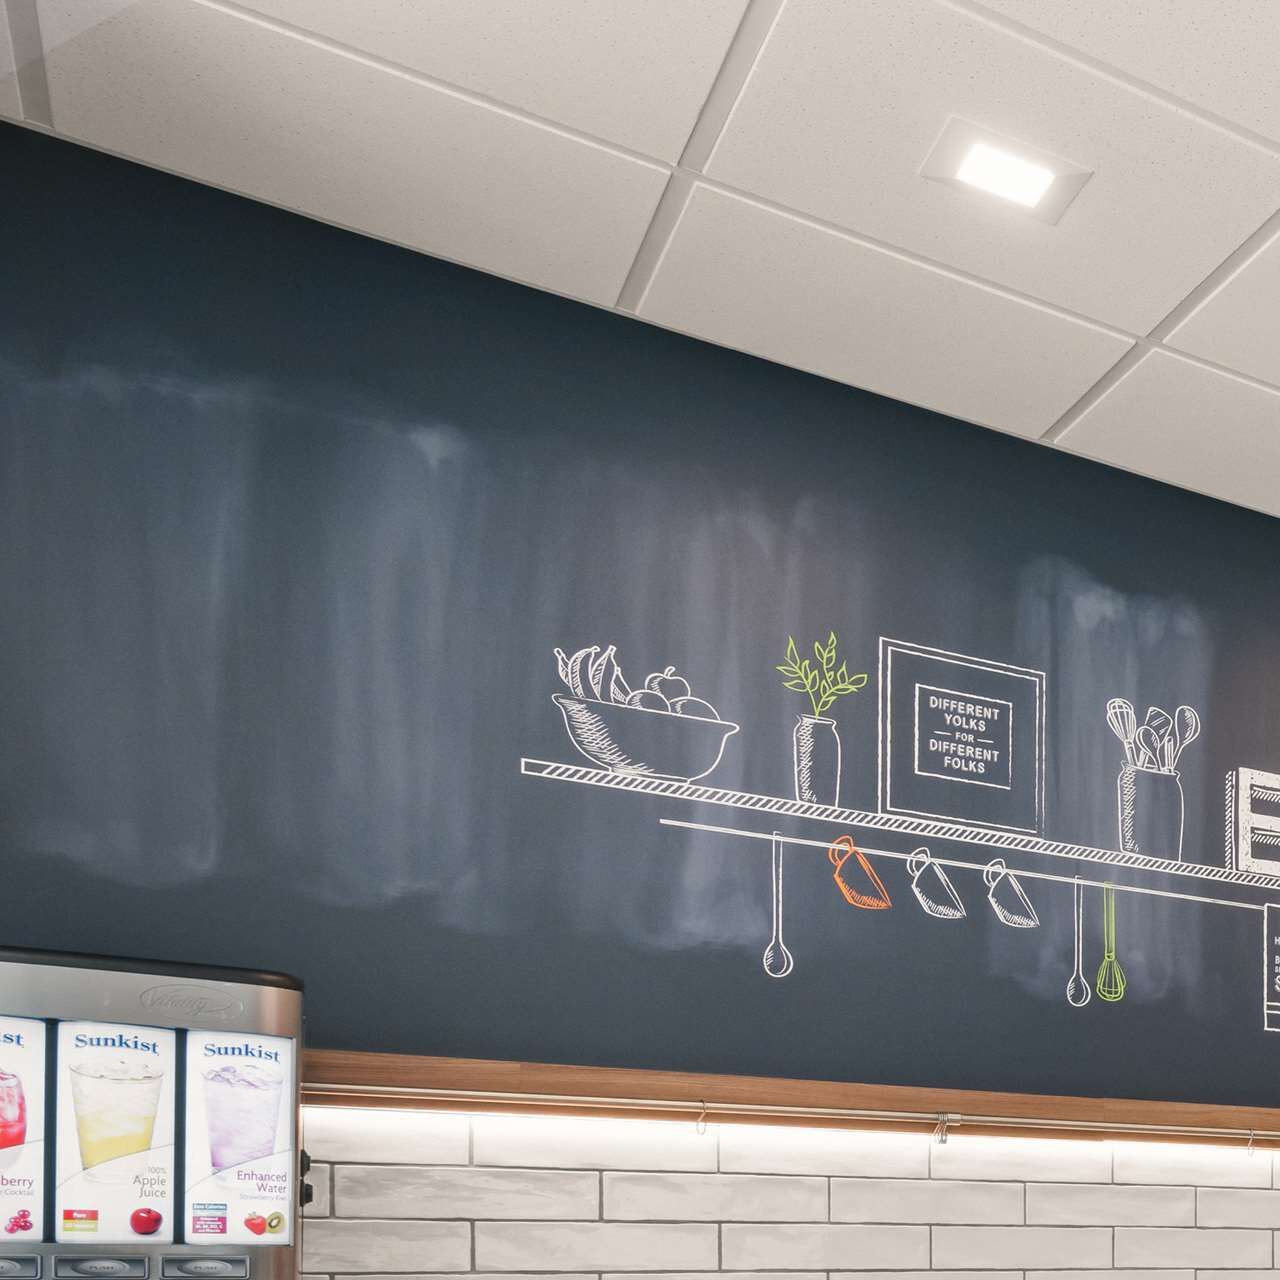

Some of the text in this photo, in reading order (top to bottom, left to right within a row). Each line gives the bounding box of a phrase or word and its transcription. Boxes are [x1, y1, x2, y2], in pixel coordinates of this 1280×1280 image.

[929, 696, 1000, 720] DIFFERENT
[944, 713, 986, 732] YOLKS
[955, 732, 975, 743] FOR
[929, 739, 1000, 762] DIFFERENT
[944, 756, 985, 774] FOLKS
[74, 1033, 159, 1056] Sunkist
[204, 1043, 280, 1063] Sunkist
[132, 1175, 167, 1188] Apple
[237, 1170, 287, 1182] Enhanced
[139, 1187, 167, 1198] Juice
[256, 1182, 287, 1193] Water
